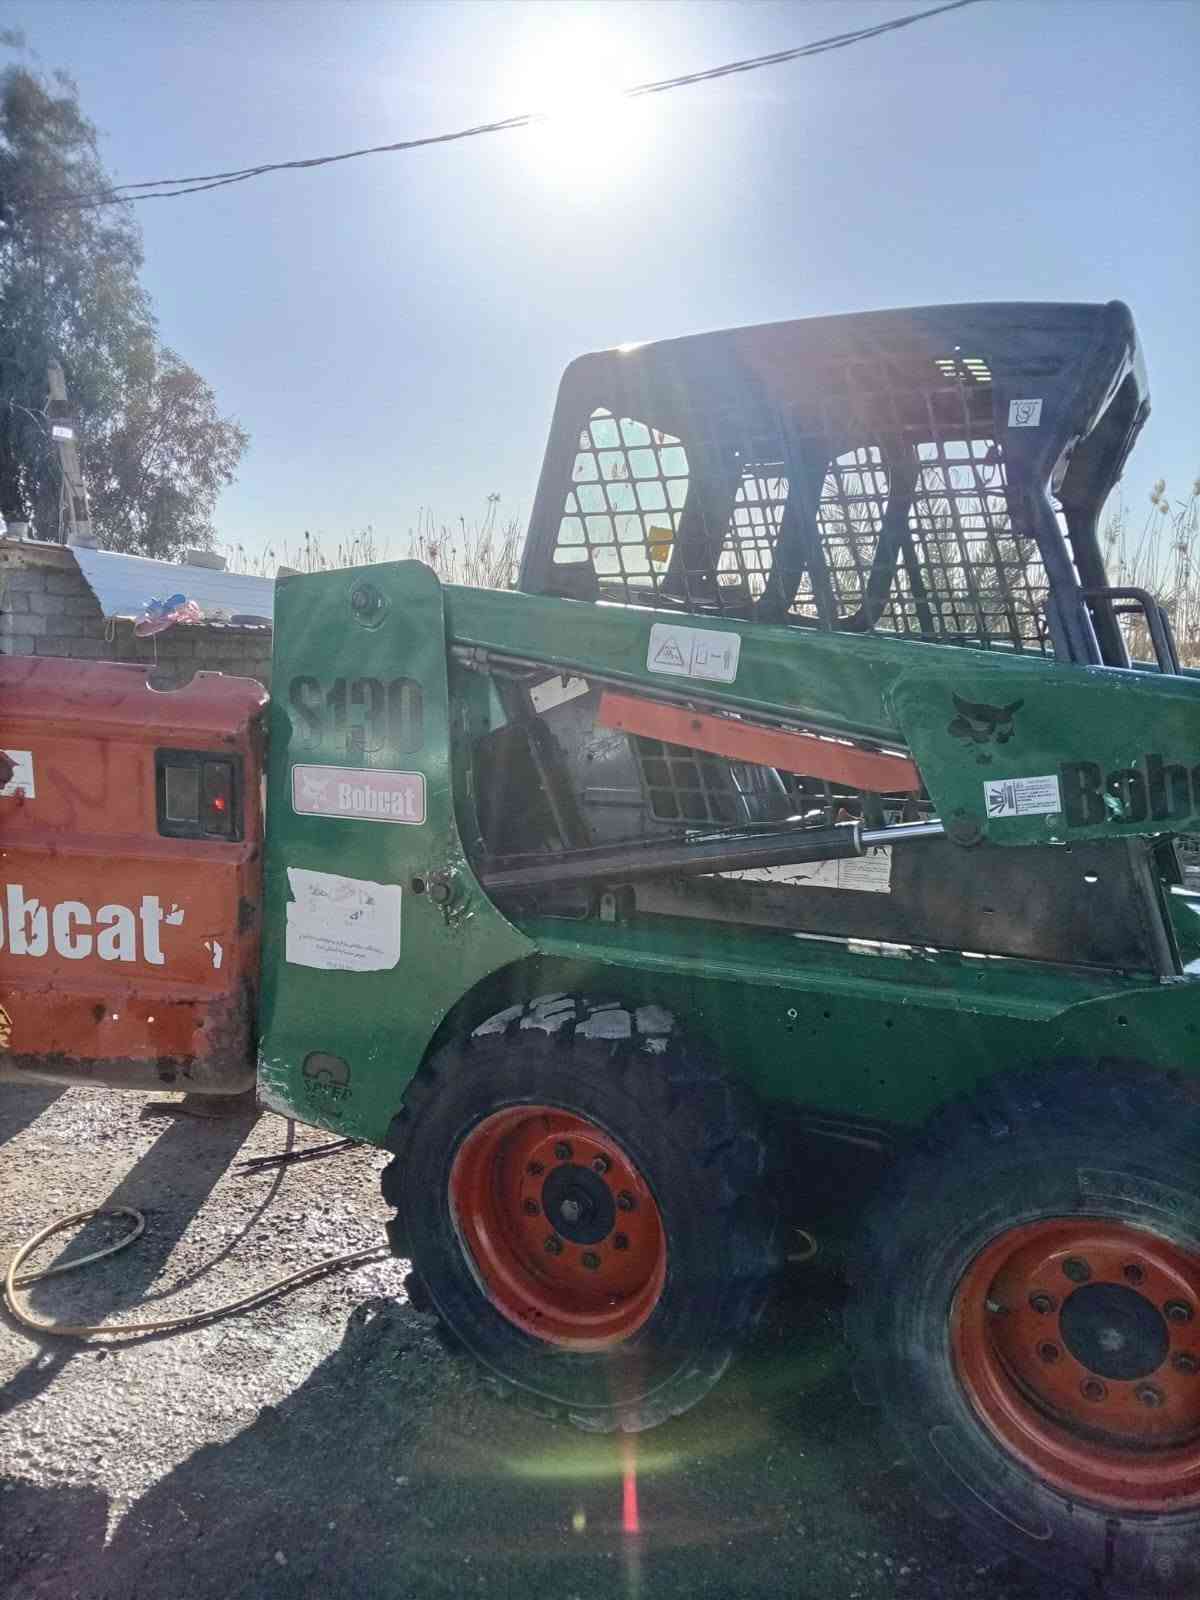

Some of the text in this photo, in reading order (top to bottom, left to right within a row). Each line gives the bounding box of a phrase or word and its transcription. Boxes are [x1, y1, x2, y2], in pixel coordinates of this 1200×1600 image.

[289, 675, 425, 754] S130
[337, 783, 417, 818] Bobcat
[1059, 752, 1200, 827] Bob
[0, 884, 166, 965] bcat
